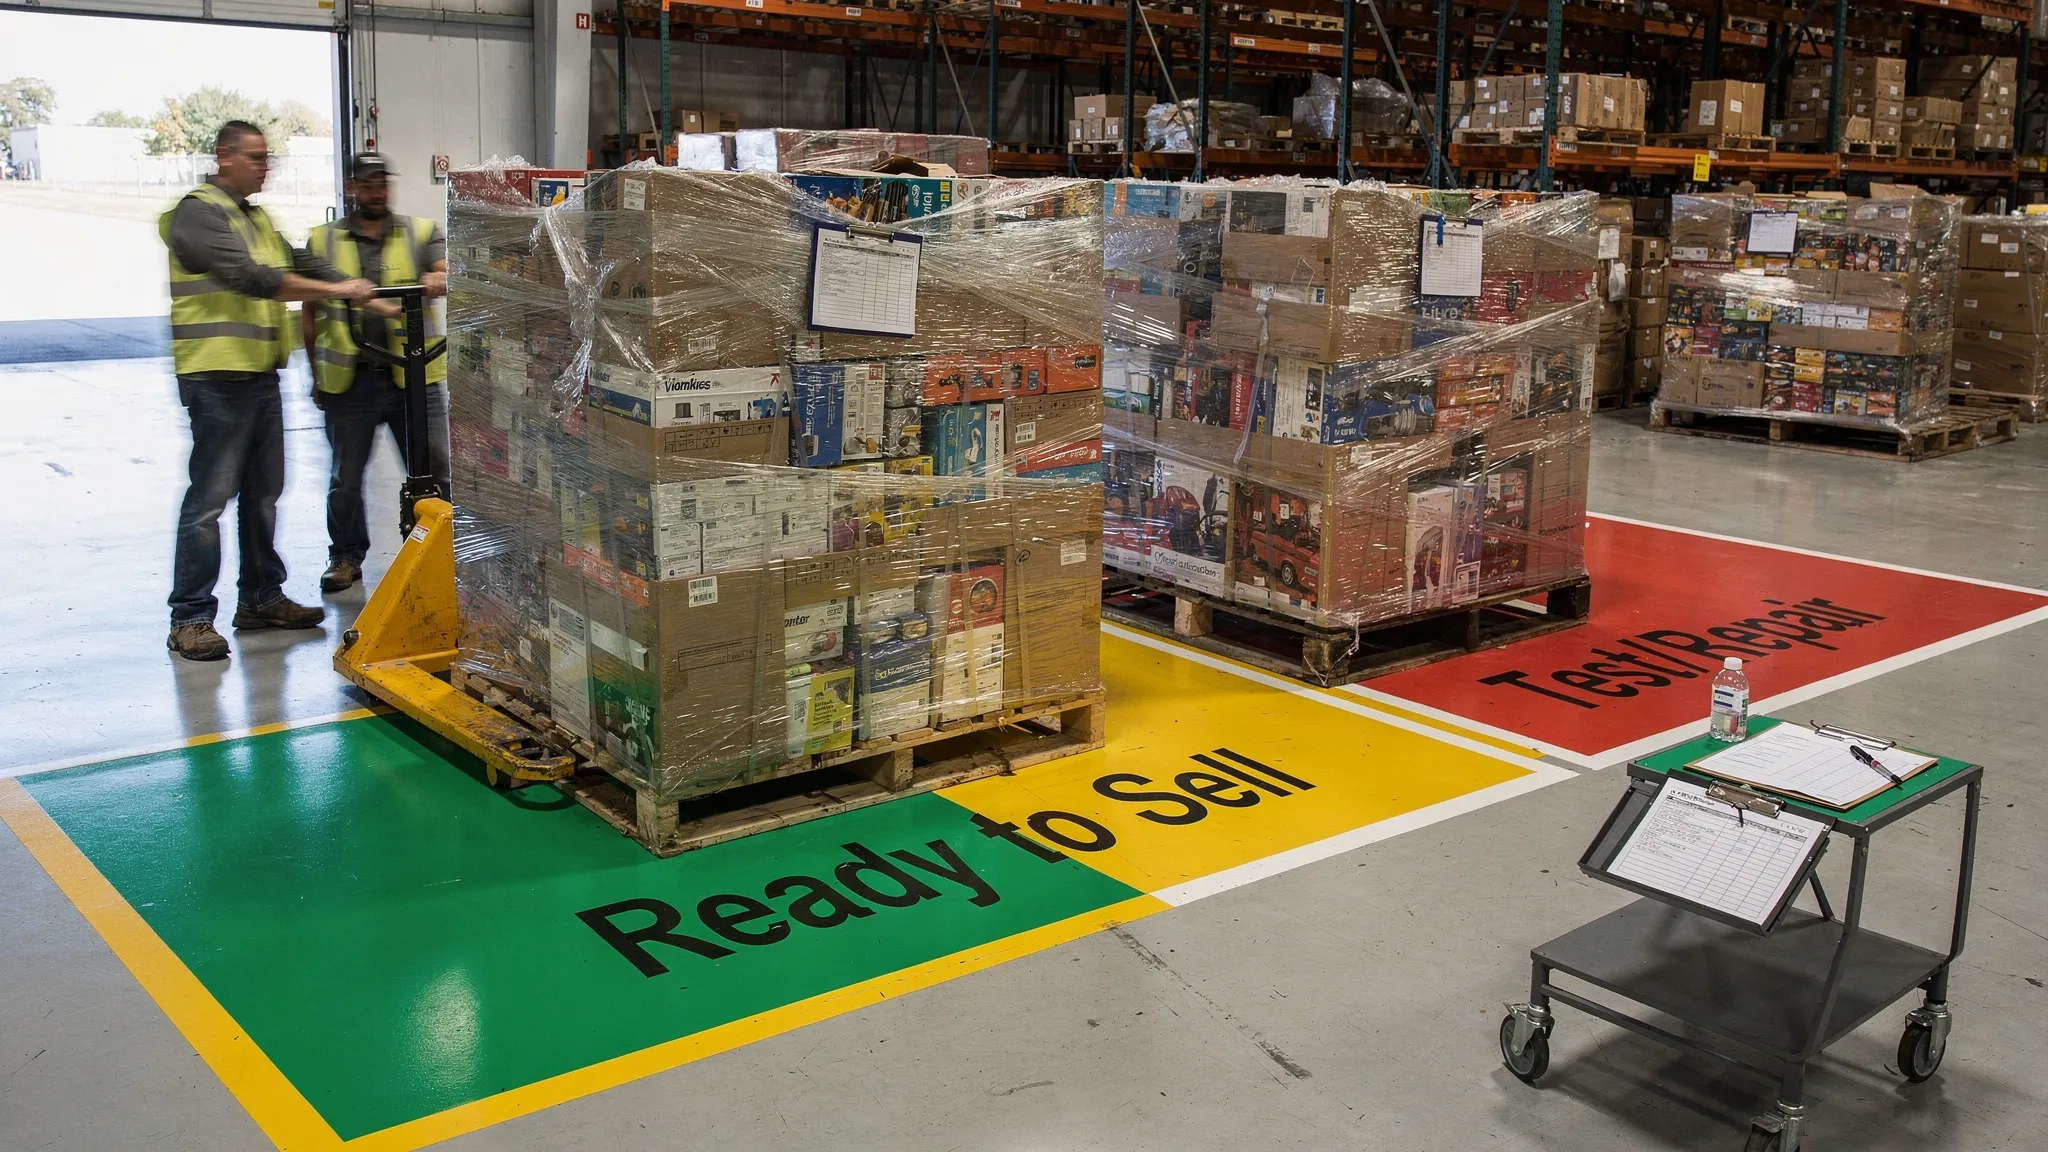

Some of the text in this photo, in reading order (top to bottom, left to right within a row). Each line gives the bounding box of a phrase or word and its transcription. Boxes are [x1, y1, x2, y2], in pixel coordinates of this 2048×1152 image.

[1477, 597, 1886, 709] Test/Repair
[574, 747, 1318, 977] Ready to Sell
